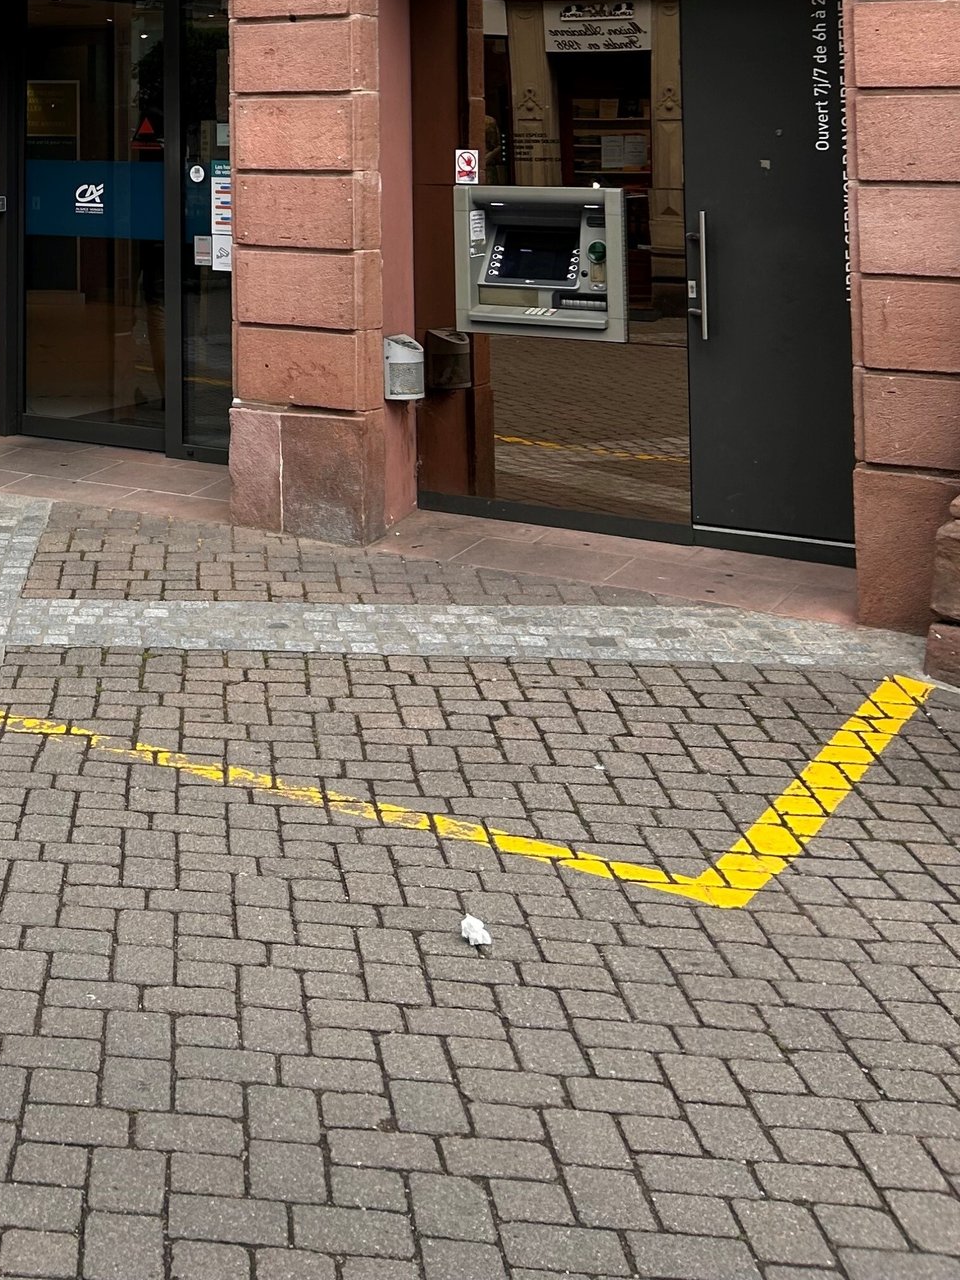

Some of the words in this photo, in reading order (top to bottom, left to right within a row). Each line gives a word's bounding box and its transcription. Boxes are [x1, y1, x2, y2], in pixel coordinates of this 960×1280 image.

[811, 10, 827, 19] à
[812, 23, 827, 41] 6h
[813, 45, 827, 64] de
[812, 68, 832, 97] 7j/7
[815, 100, 830, 151] Ouvert
